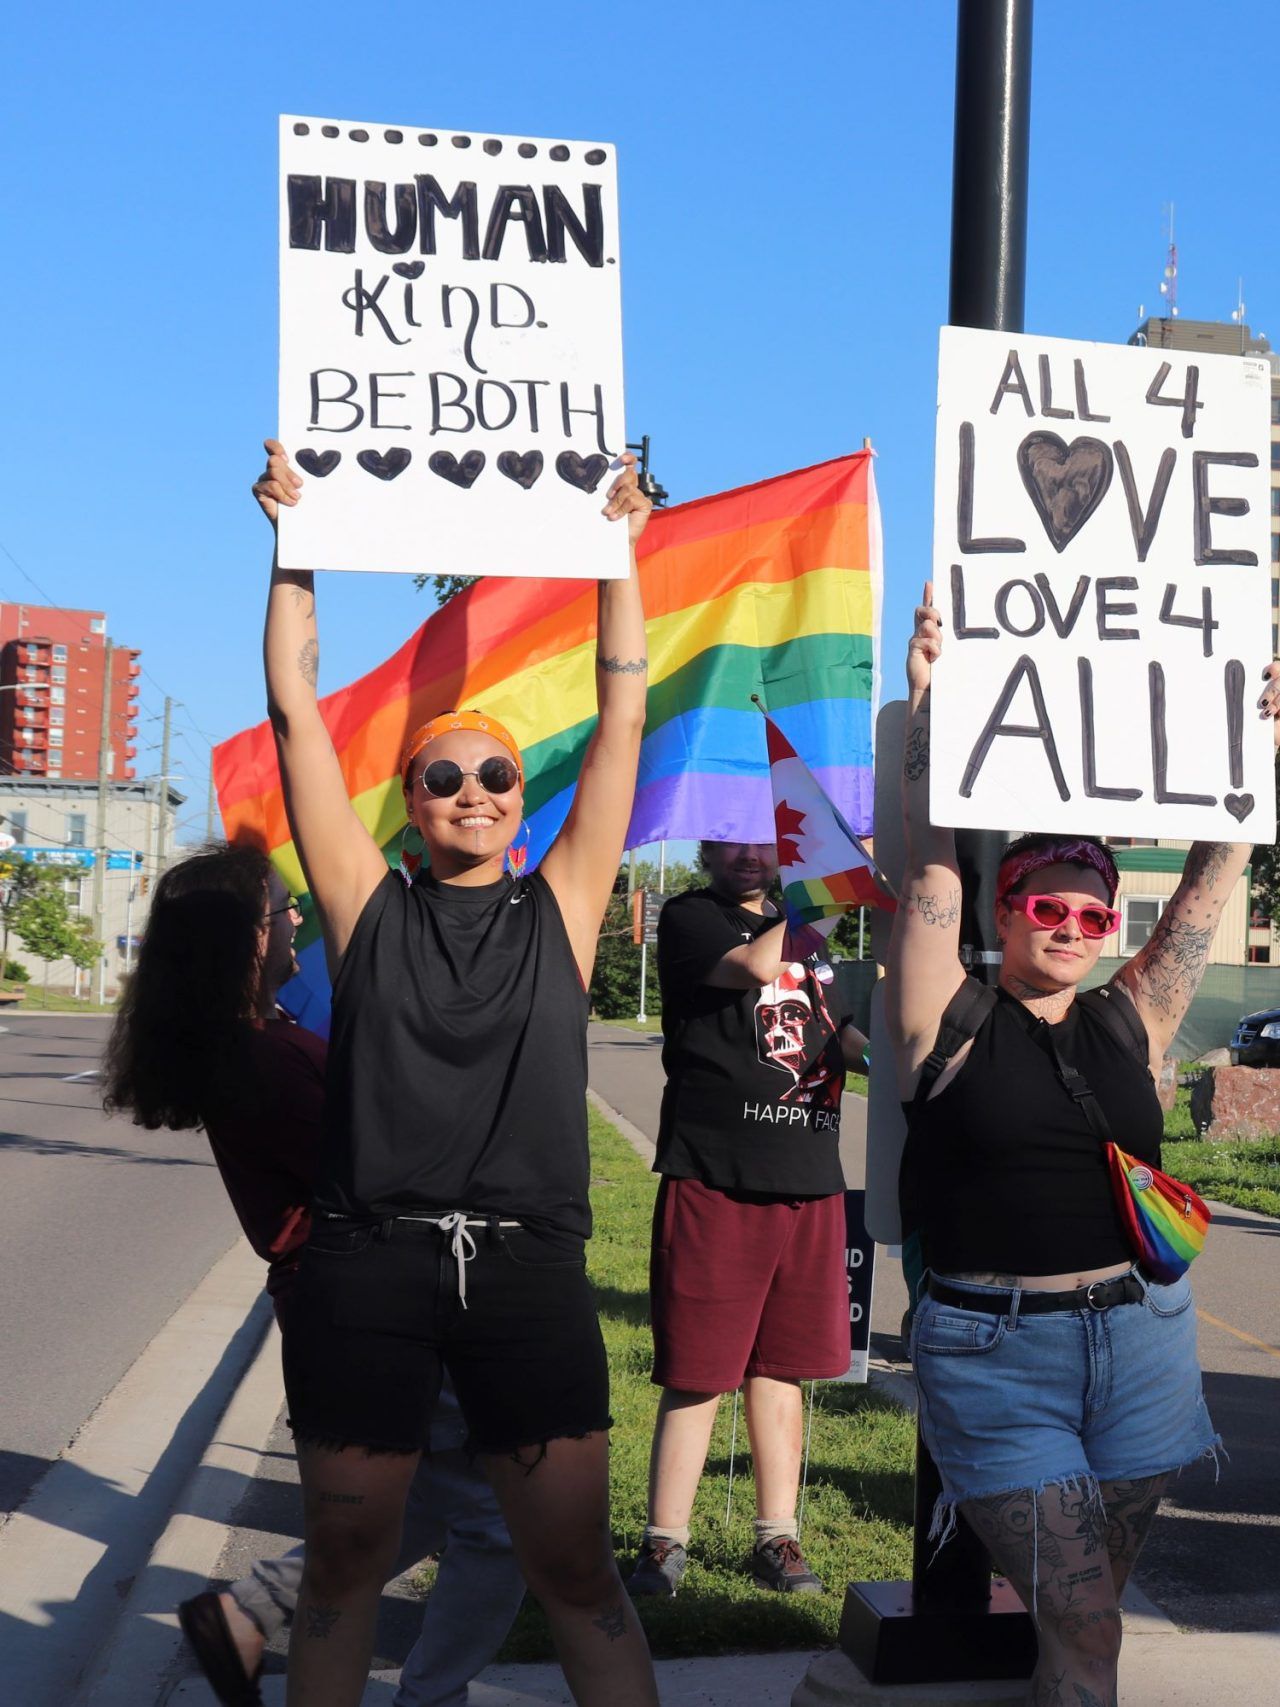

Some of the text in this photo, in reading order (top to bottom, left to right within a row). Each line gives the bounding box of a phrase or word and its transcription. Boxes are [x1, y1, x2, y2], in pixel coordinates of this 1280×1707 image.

[306, 369, 617, 456] BE BOTH
[990, 349, 1204, 438] ALL 4
[950, 564, 1219, 657] LOVE 4
[743, 1102, 811, 1127] HAPPY
